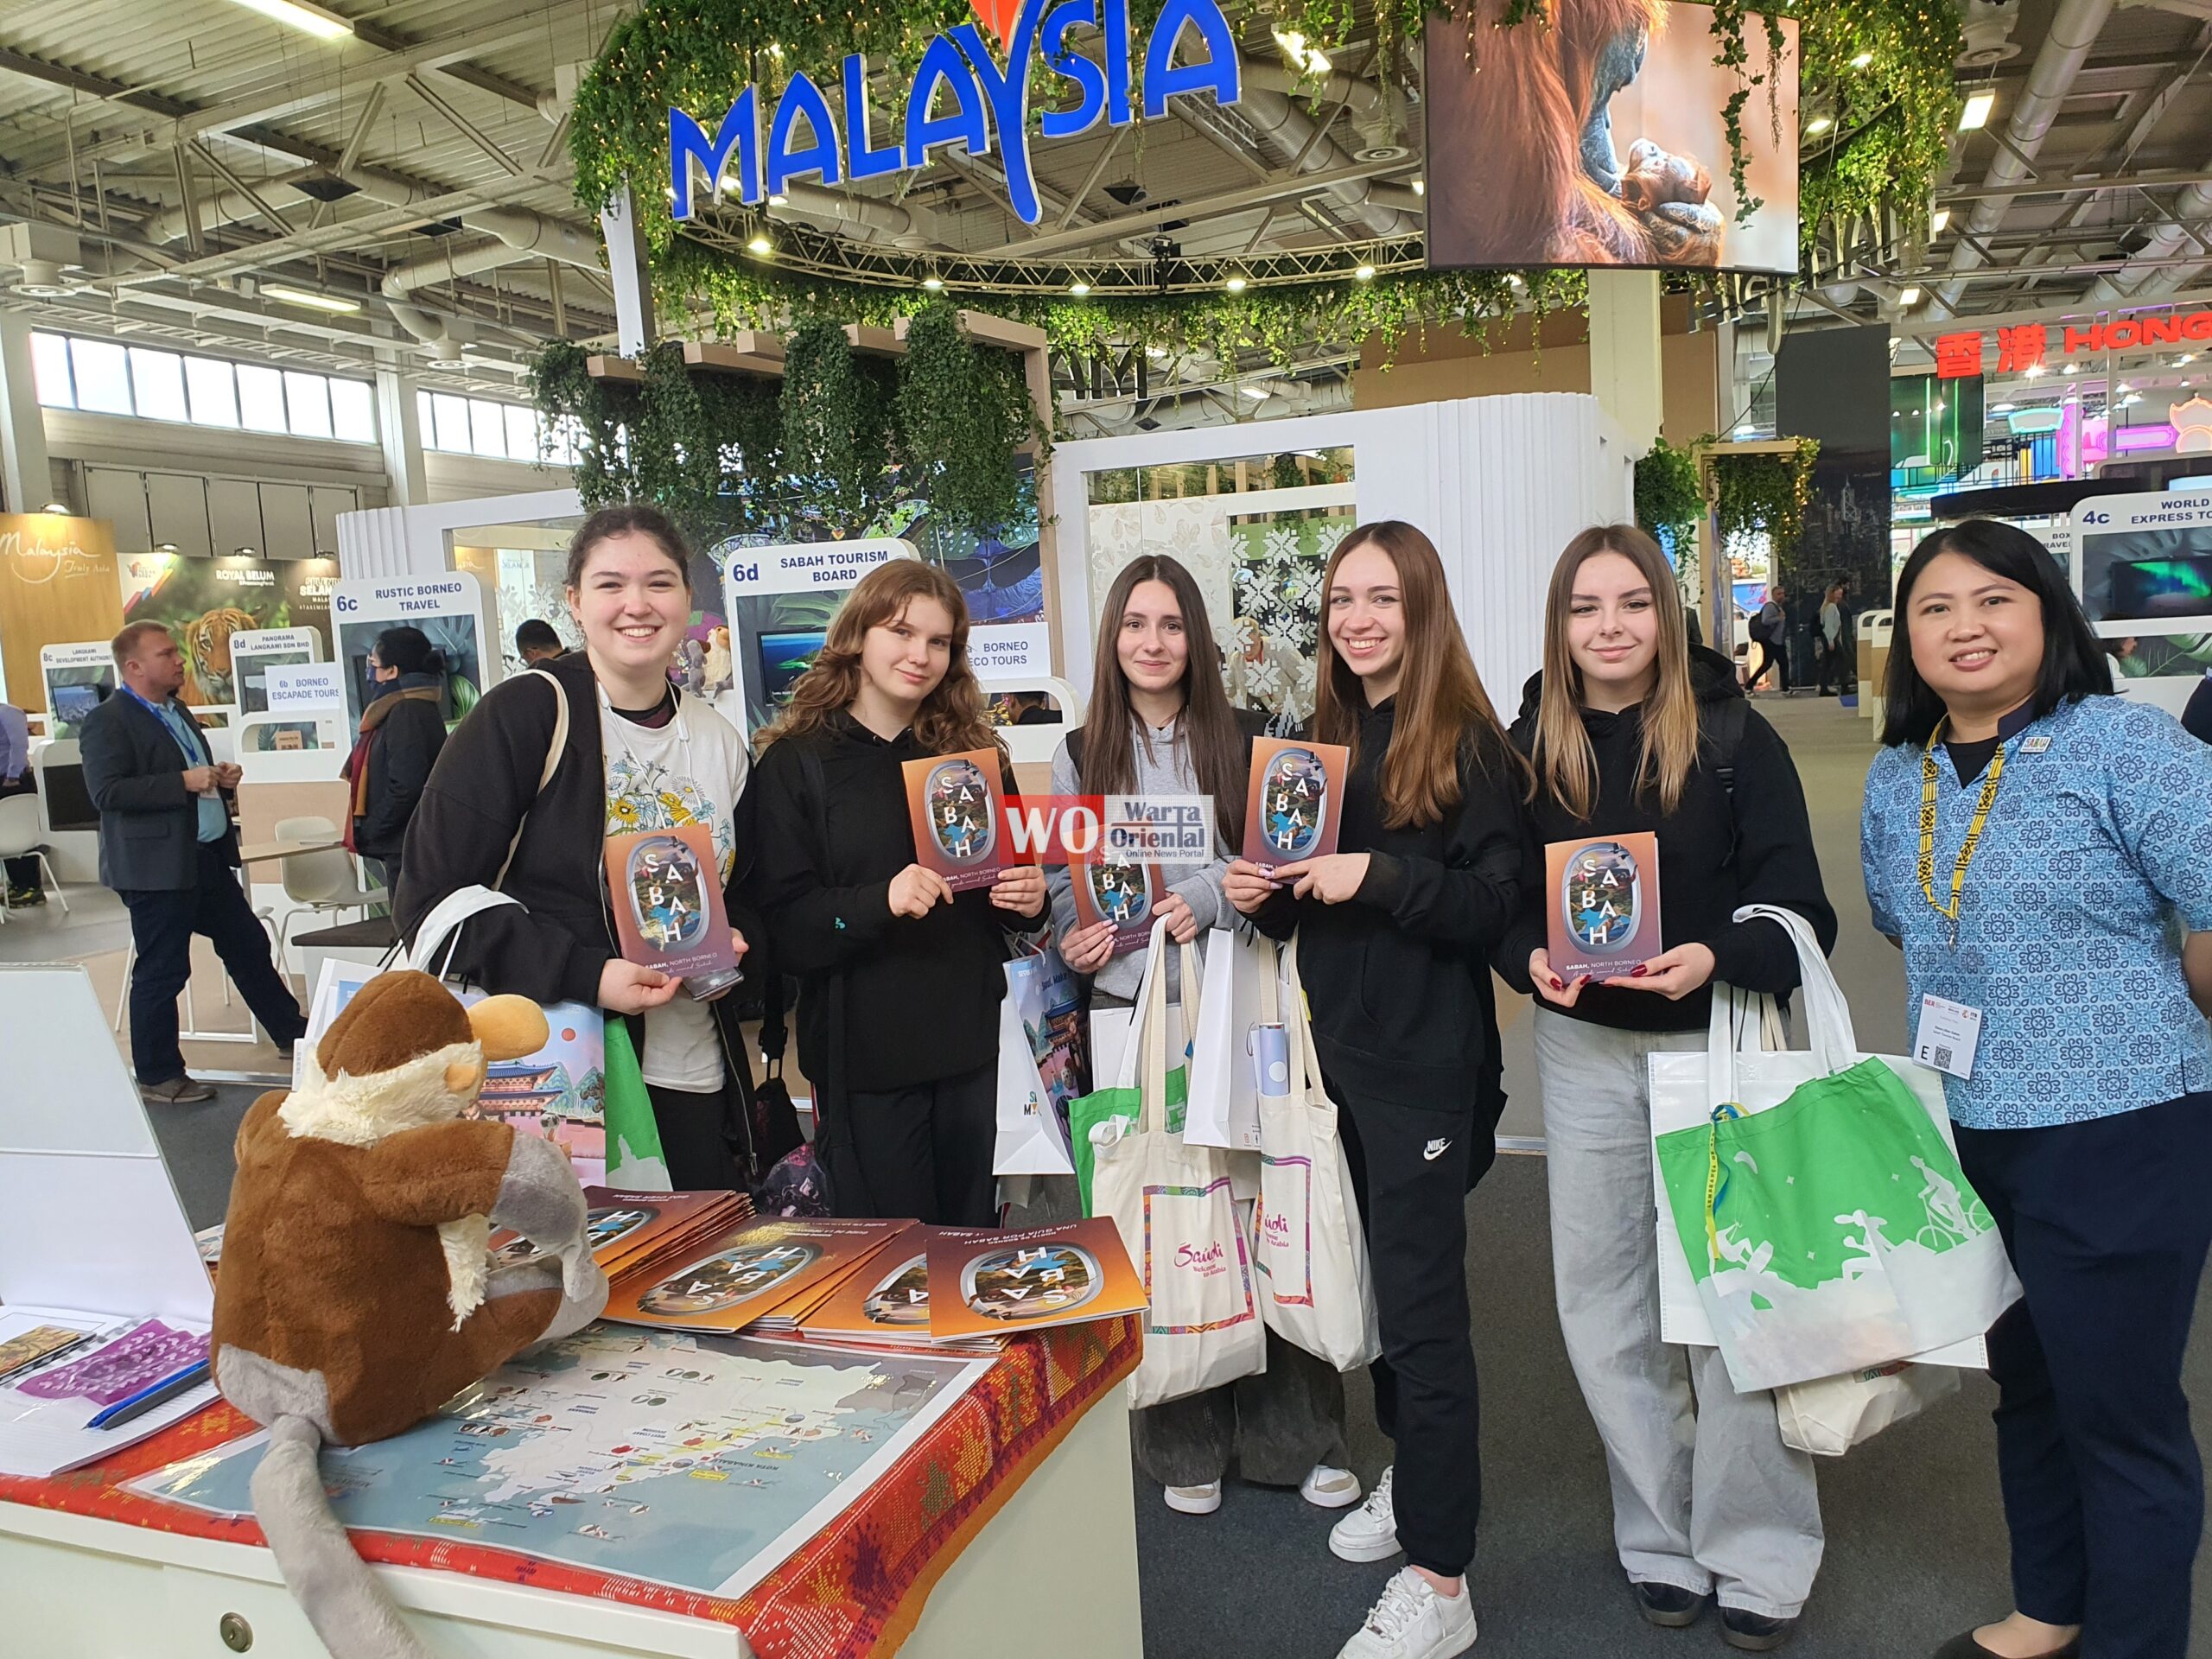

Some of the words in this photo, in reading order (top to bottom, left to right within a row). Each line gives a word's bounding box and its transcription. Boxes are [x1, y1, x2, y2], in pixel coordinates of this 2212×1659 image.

[669, 0, 1242, 225] MALAYSIA
[2064, 312, 2212, 353] HONG
[1936, 323, 2046, 378] 香港
[2161, 499, 2209, 510] WORLD
[2082, 511, 2110, 524] 4c
[2131, 512, 2193, 524] EXPRESS
[0, 531, 101, 577] Malaysia
[64, 560, 90, 573] Truly
[733, 563, 759, 582] 6d
[780, 556, 823, 569] SABAH
[828, 550, 888, 565] TOURISM
[216, 569, 245, 580] ROYAL
[813, 569, 857, 582] BOARD
[336, 595, 358, 611] 6c
[375, 587, 414, 599] RUSTIC
[417, 582, 461, 595] BORNEO
[399, 600, 440, 611] TRAVEL
[262, 634, 295, 643] PANORAMA
[983, 641, 1028, 652] BORNEO
[968, 657, 988, 666] ECO
[991, 655, 1027, 665] TOURS
[279, 679, 289, 688] 6b
[296, 677, 329, 688] BORNEO
[272, 690, 313, 700] ESCAPADE
[1275, 762, 1309, 850] SABAH
[941, 776, 976, 858] SABAH
[644, 853, 687, 944] SABAH
[1582, 859, 1618, 945] SABAH
[669, 957, 691, 966] NORTH
[1920, 1045, 1929, 1060] E
[1427, 1137, 1446, 1152] NIKE
